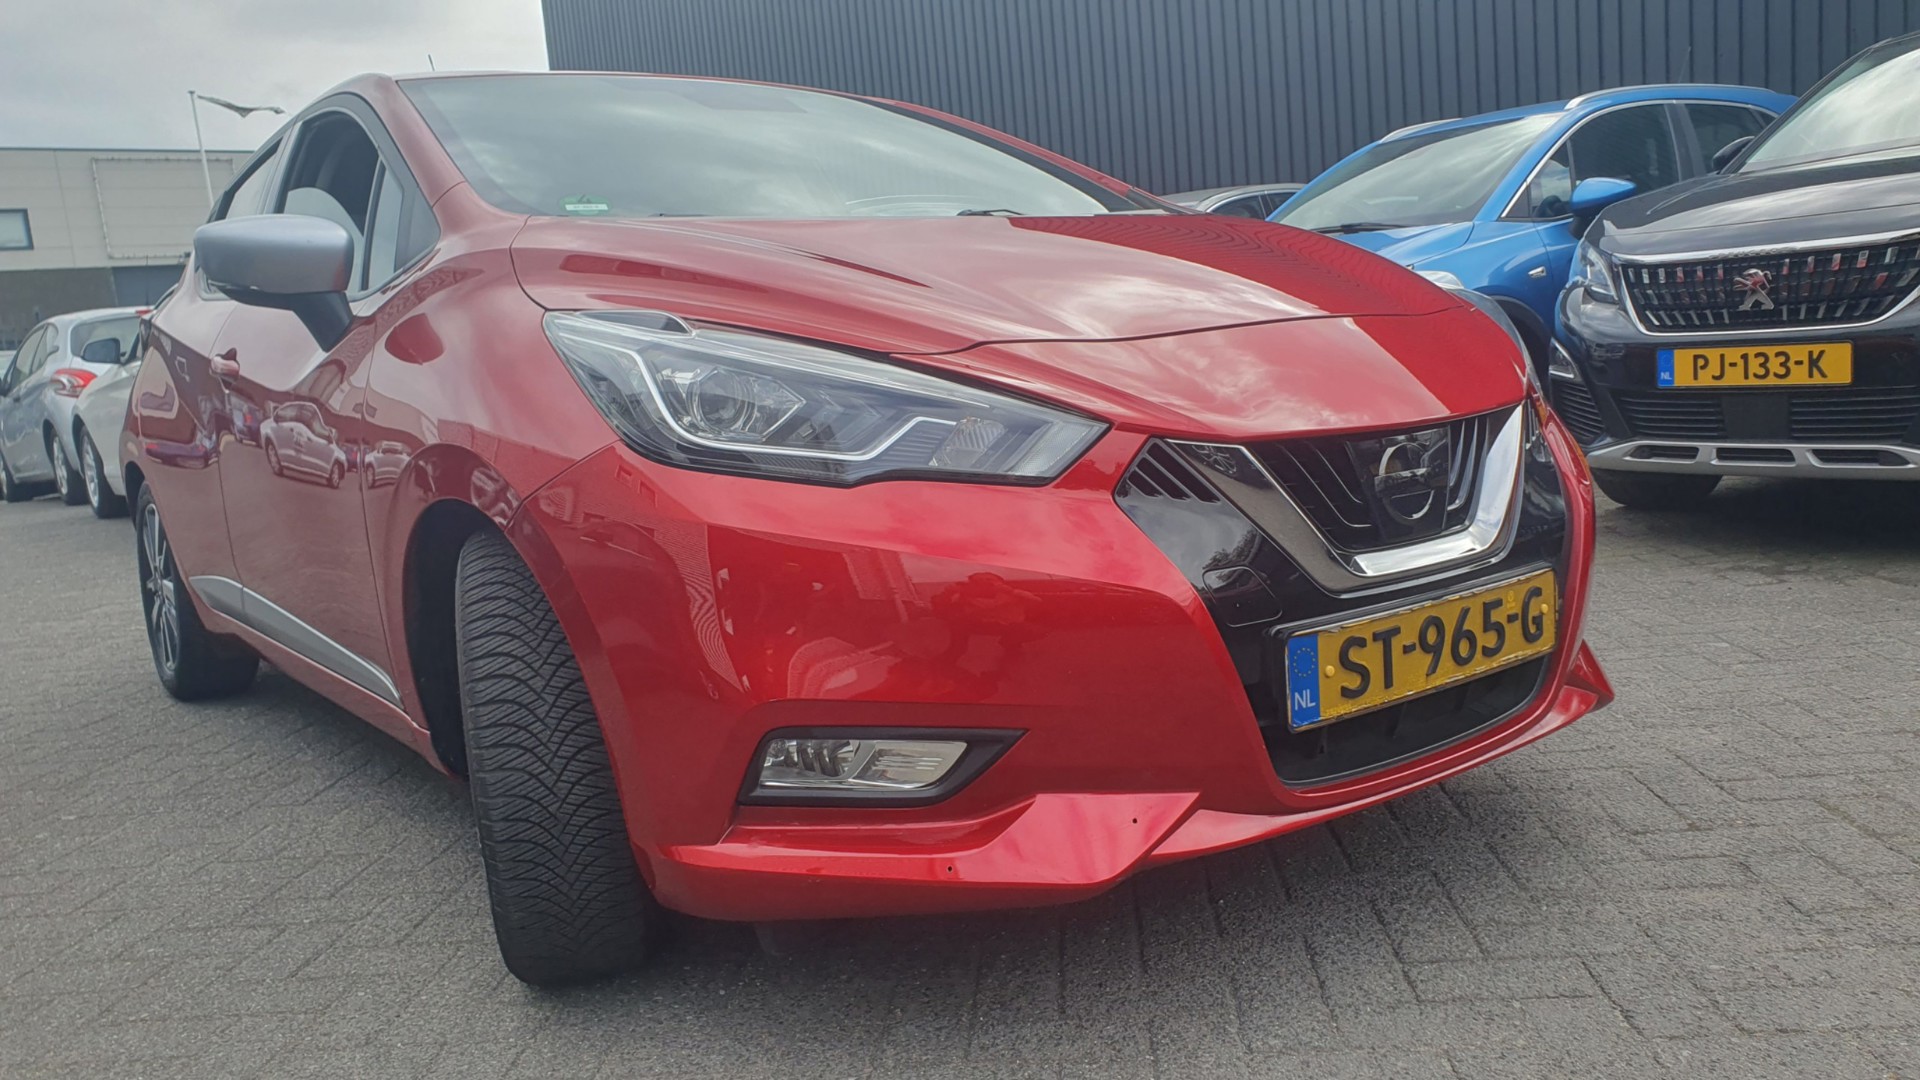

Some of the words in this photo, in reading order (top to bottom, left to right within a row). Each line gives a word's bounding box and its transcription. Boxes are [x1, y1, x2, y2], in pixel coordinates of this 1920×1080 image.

[1660, 371, 1673, 380] NL
[1692, 350, 1828, 381] PJ-133-K
[1338, 586, 1544, 699] ST-965-G
[1294, 689, 1316, 710] NL
